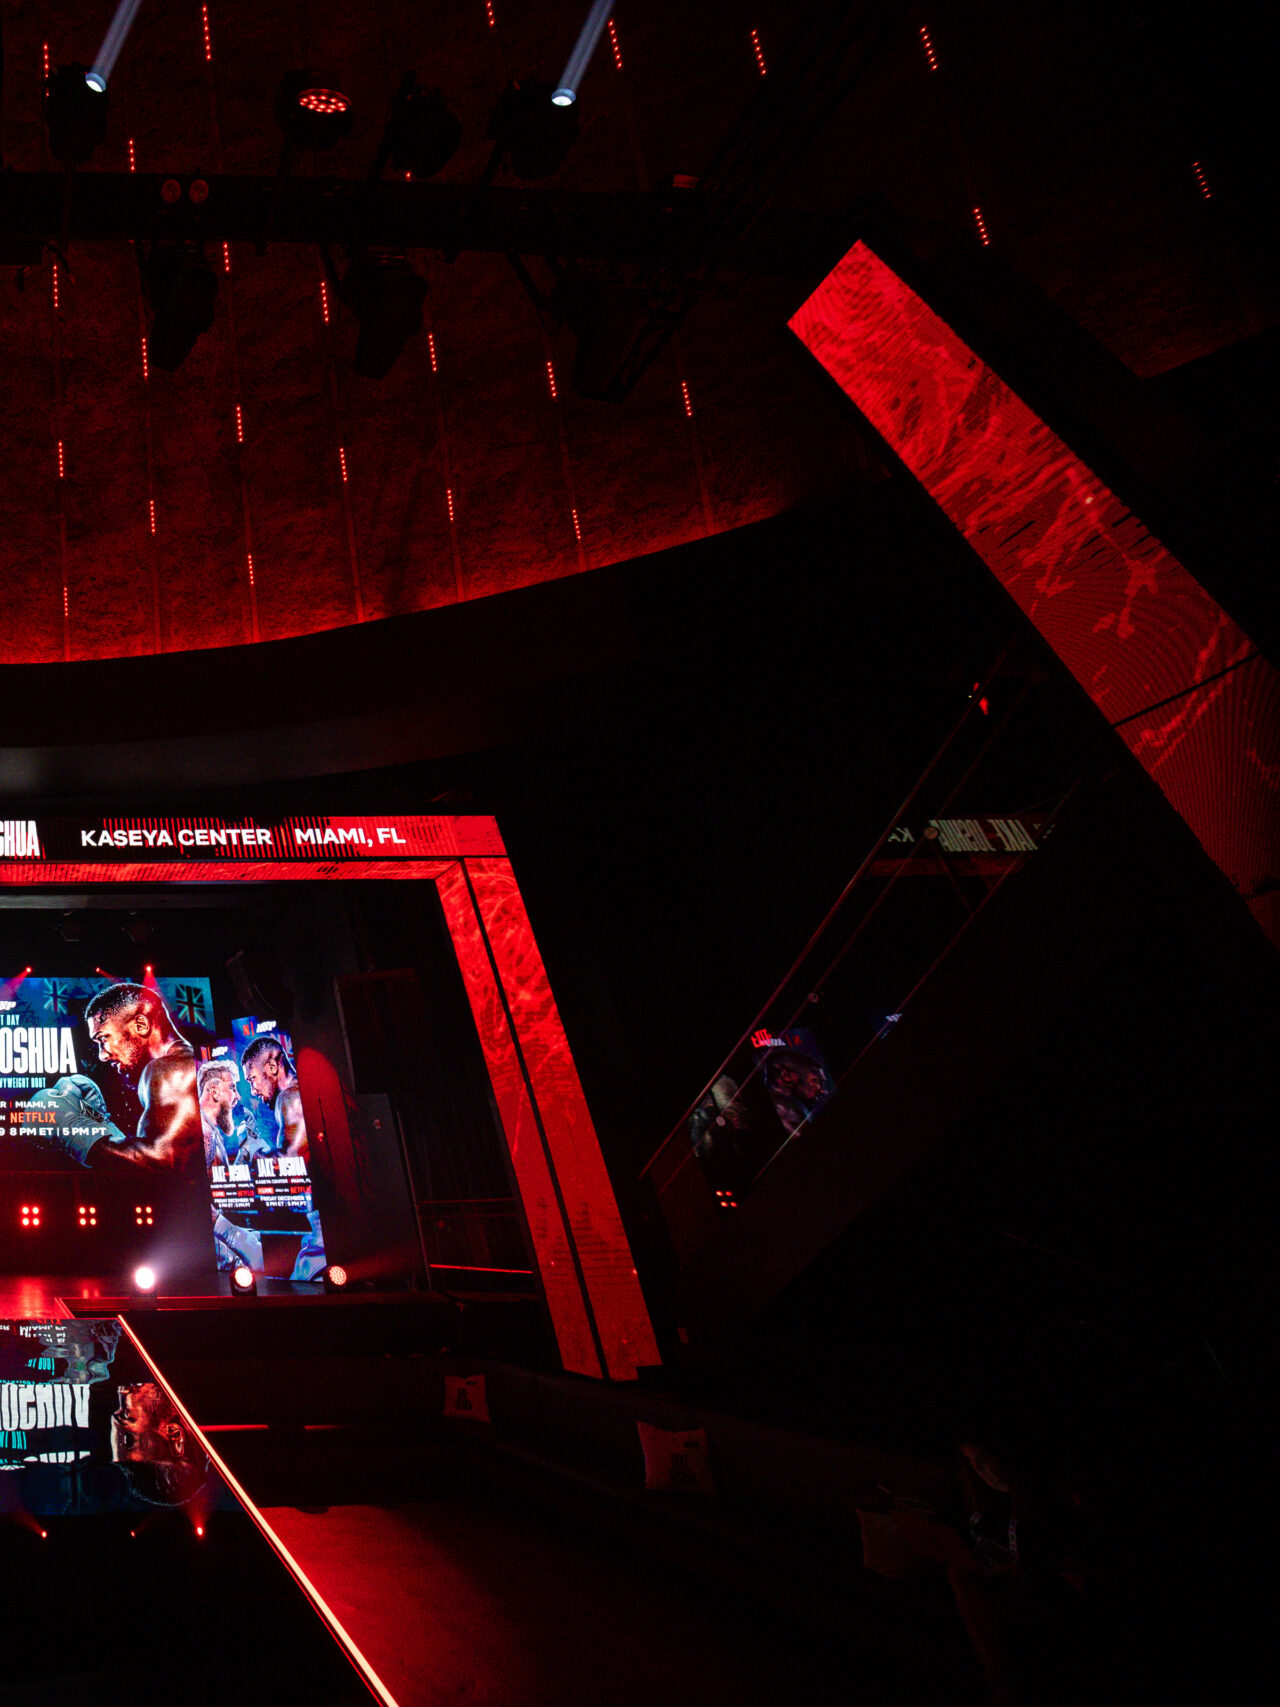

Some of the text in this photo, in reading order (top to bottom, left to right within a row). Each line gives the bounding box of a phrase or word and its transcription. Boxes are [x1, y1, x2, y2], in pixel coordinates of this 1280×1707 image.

[81, 828, 406, 847] KASEYA CENTER MIAMI, FL
[6, 1014, 20, 1026] DAY
[15, 1101, 46, 1110] MIAMI,
[48, 1101, 59, 1109] FL
[10, 1112, 56, 1124] NETFLIX
[9, 1127, 17, 1137] 8
[19, 1127, 37, 1137] PM
[39, 1127, 54, 1137] ET
[62, 1127, 107, 1137] 5 PM PT
[257, 1157, 276, 1178] JAKE
